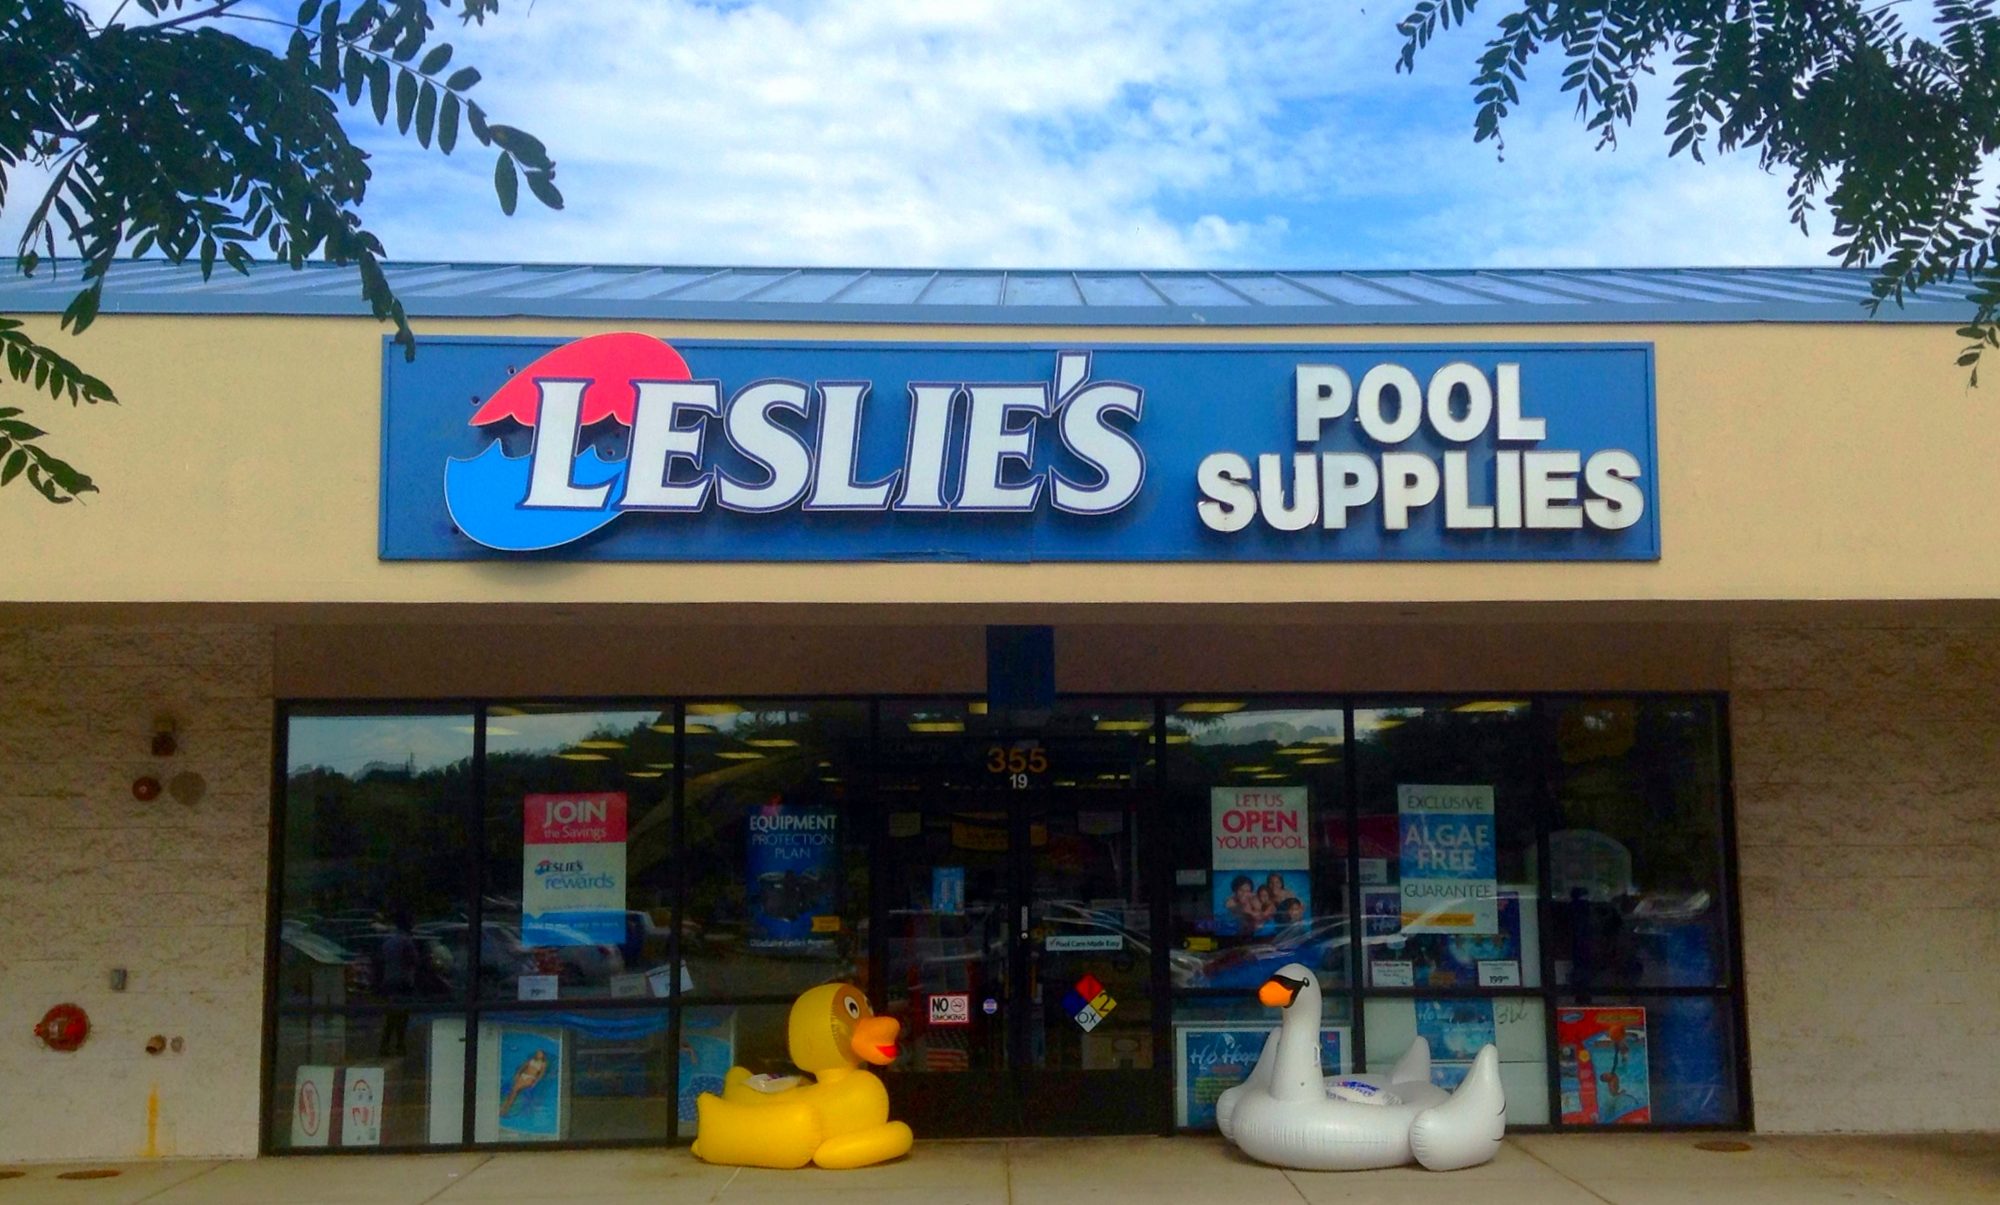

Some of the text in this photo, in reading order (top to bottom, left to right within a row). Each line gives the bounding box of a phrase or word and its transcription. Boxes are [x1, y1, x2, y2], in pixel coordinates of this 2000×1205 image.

[1295, 361, 1546, 444] POOL
[516, 350, 1146, 514] LESLIE'S
[1196, 449, 1644, 532] SUPPLIES
[986, 747, 1048, 774] 355
[1008, 774, 1028, 789] 19
[1235, 793, 1285, 807] LET US
[1407, 797, 1484, 810] EXCLUSIVE
[544, 799, 607, 827] JOIN
[750, 815, 838, 832] EQUIPMENT
[1222, 810, 1298, 834] OPEN
[544, 826, 607, 843] the Savings
[752, 833, 834, 846] PROTECTION
[1216, 836, 1306, 850] YOUR POOL
[1405, 824, 1491, 848] ALGAE
[775, 848, 812, 859] PLAN
[1416, 849, 1478, 871] FREE
[545, 873, 615, 890] rewards
[1404, 884, 1493, 899] GUARANTEE
[932, 997, 949, 1012] NO
[1098, 992, 1111, 1012] 2
[932, 1013, 966, 1021] SMOKING
[1077, 1011, 1097, 1024] OX
